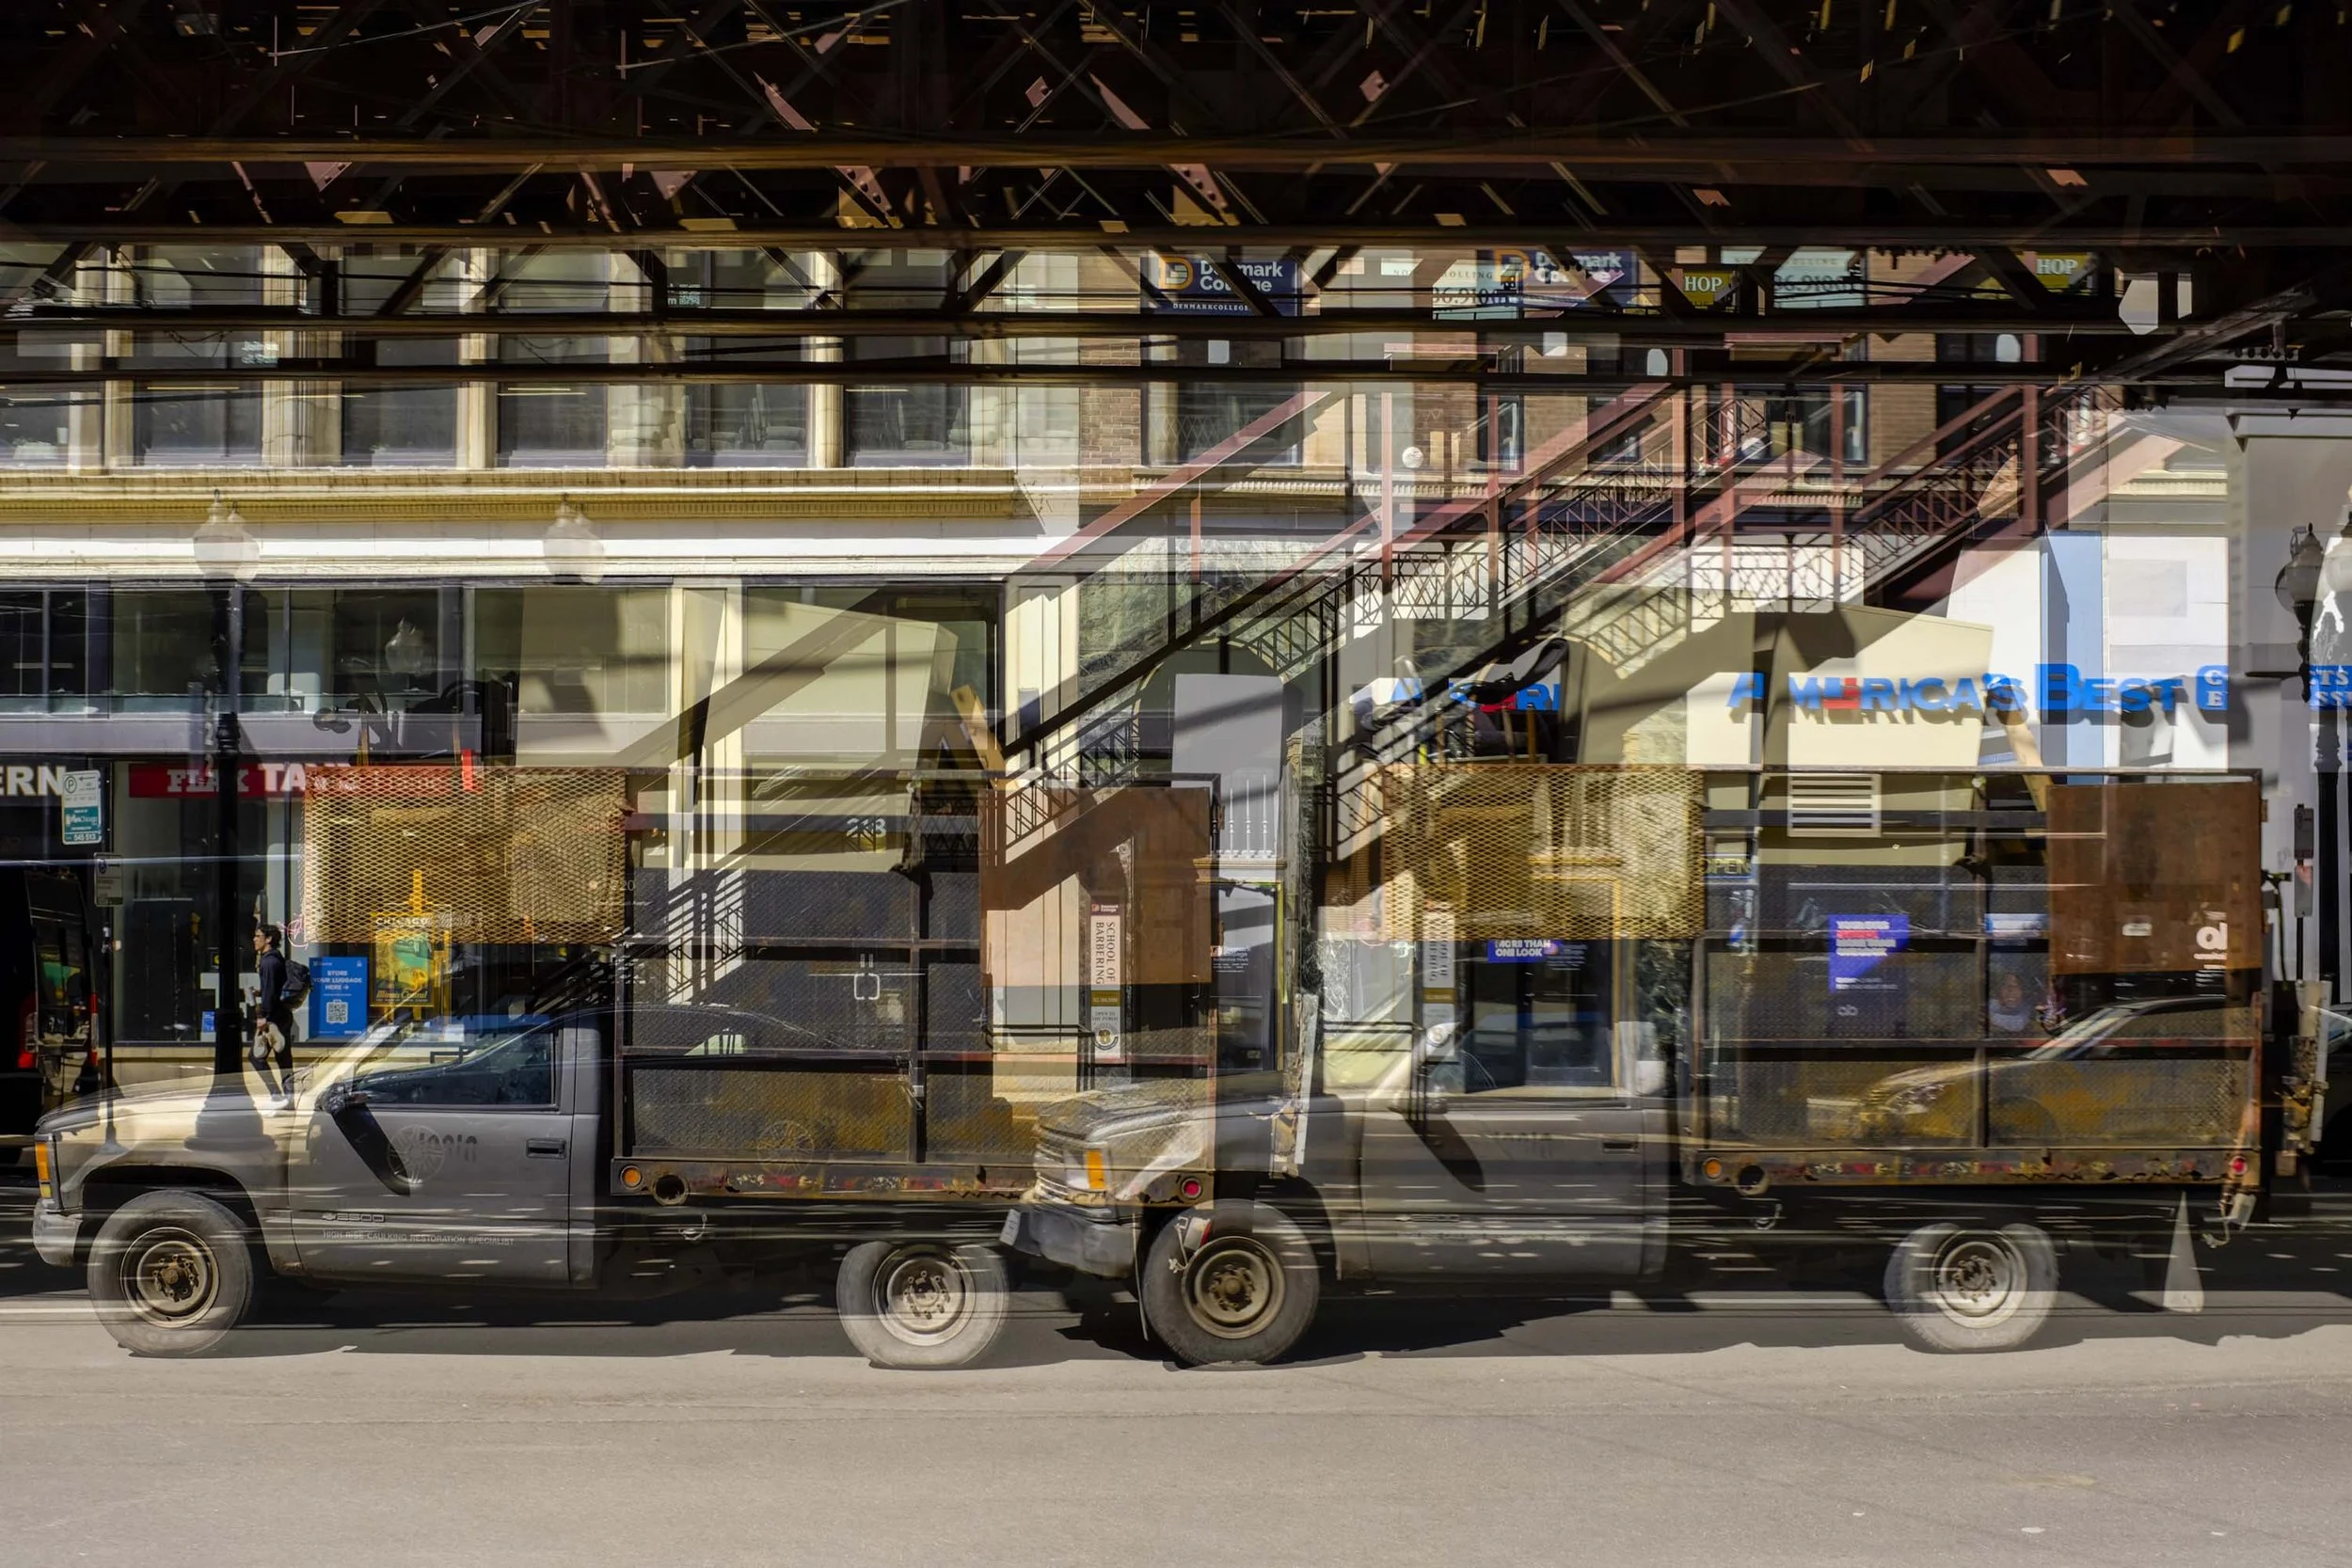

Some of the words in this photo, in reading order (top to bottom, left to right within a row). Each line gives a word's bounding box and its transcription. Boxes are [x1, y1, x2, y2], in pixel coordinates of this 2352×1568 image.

[1105, 922, 1116, 963] SCHOOL
[1095, 922, 1105, 985] BARBERING
[1517, 948, 1543, 957] LOOK
[1106, 967, 1116, 981] OF
[337, 1212, 385, 1222] 2500
[367, 1232, 406, 1242] CAULKING
[410, 1234, 465, 1243] RESTORATION
[469, 1235, 515, 1246] SPECIALIST
